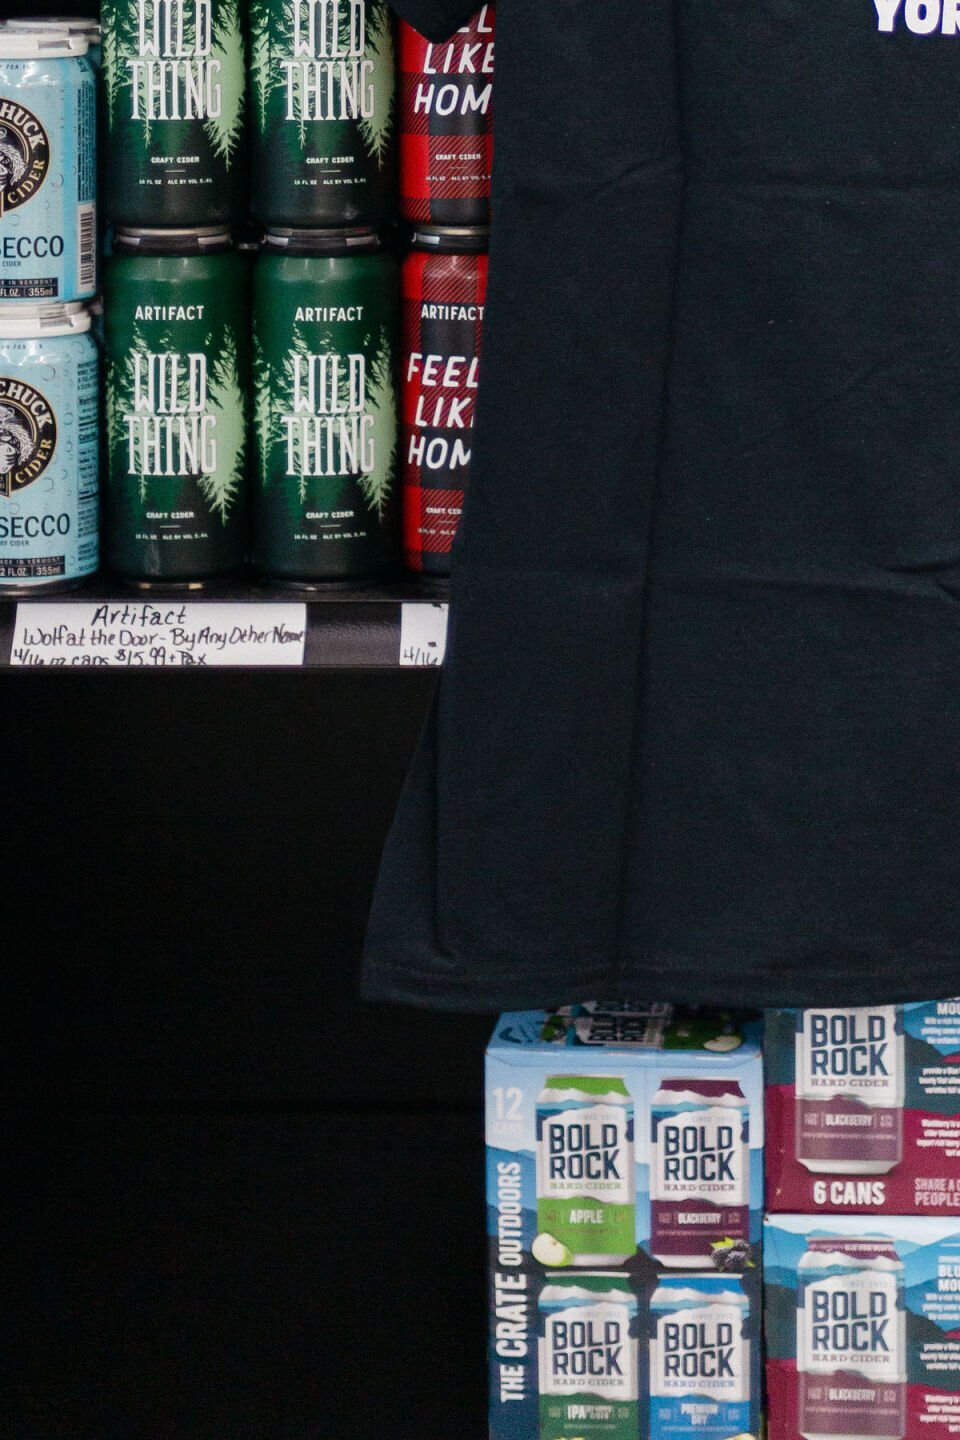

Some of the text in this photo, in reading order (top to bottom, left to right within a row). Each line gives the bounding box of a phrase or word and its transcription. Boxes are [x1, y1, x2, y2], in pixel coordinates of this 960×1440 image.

[126, 59, 222, 121] THING
[280, 59, 375, 121] THING
[413, 83, 493, 117] HOM
[151, 156, 200, 164] CRAFT CIDER
[6, 158, 45, 205] CIDER
[135, 304, 205, 321] ARTIFACT
[294, 305, 364, 322] ARTIFACT
[421, 304, 485, 321] ARTIFACT
[132, 352, 207, 414] WILD
[291, 353, 366, 415] WILD
[407, 354, 479, 389] FEEL
[414, 395, 475, 429] LIK
[123, 414, 217, 476] THING
[280, 414, 376, 476] THING
[15, 439, 53, 485] CIDER
[91, 604, 186, 627] Artifact
[23, 624, 68, 646] Wolf
[67, 628, 85, 646] at
[90, 628, 116, 646] the
[170, 627, 196, 651] By
[198, 626, 227, 650] Any
[229, 624, 272, 645] Other
[811, 1013, 885, 1048] BOLD
[811, 1043, 888, 1076] ROCK
[811, 1078, 889, 1088] HARD CIDER
[493, 1087, 523, 1121] 12
[550, 1123, 618, 1154] BOLD
[664, 1125, 733, 1156] BOLD
[550, 1149, 622, 1180] ROCK
[664, 1151, 735, 1181] ROCK
[813, 1181, 886, 1206] 6 CANS
[495, 1161, 529, 1402] THE CRATE OUTDOORS
[812, 1290, 887, 1323] BOLD
[553, 1320, 621, 1351] BOLD
[664, 1322, 733, 1353] BOLD
[812, 1319, 890, 1352] ROCK
[553, 1346, 624, 1376] ROCK
[664, 1348, 735, 1378] ROCK
